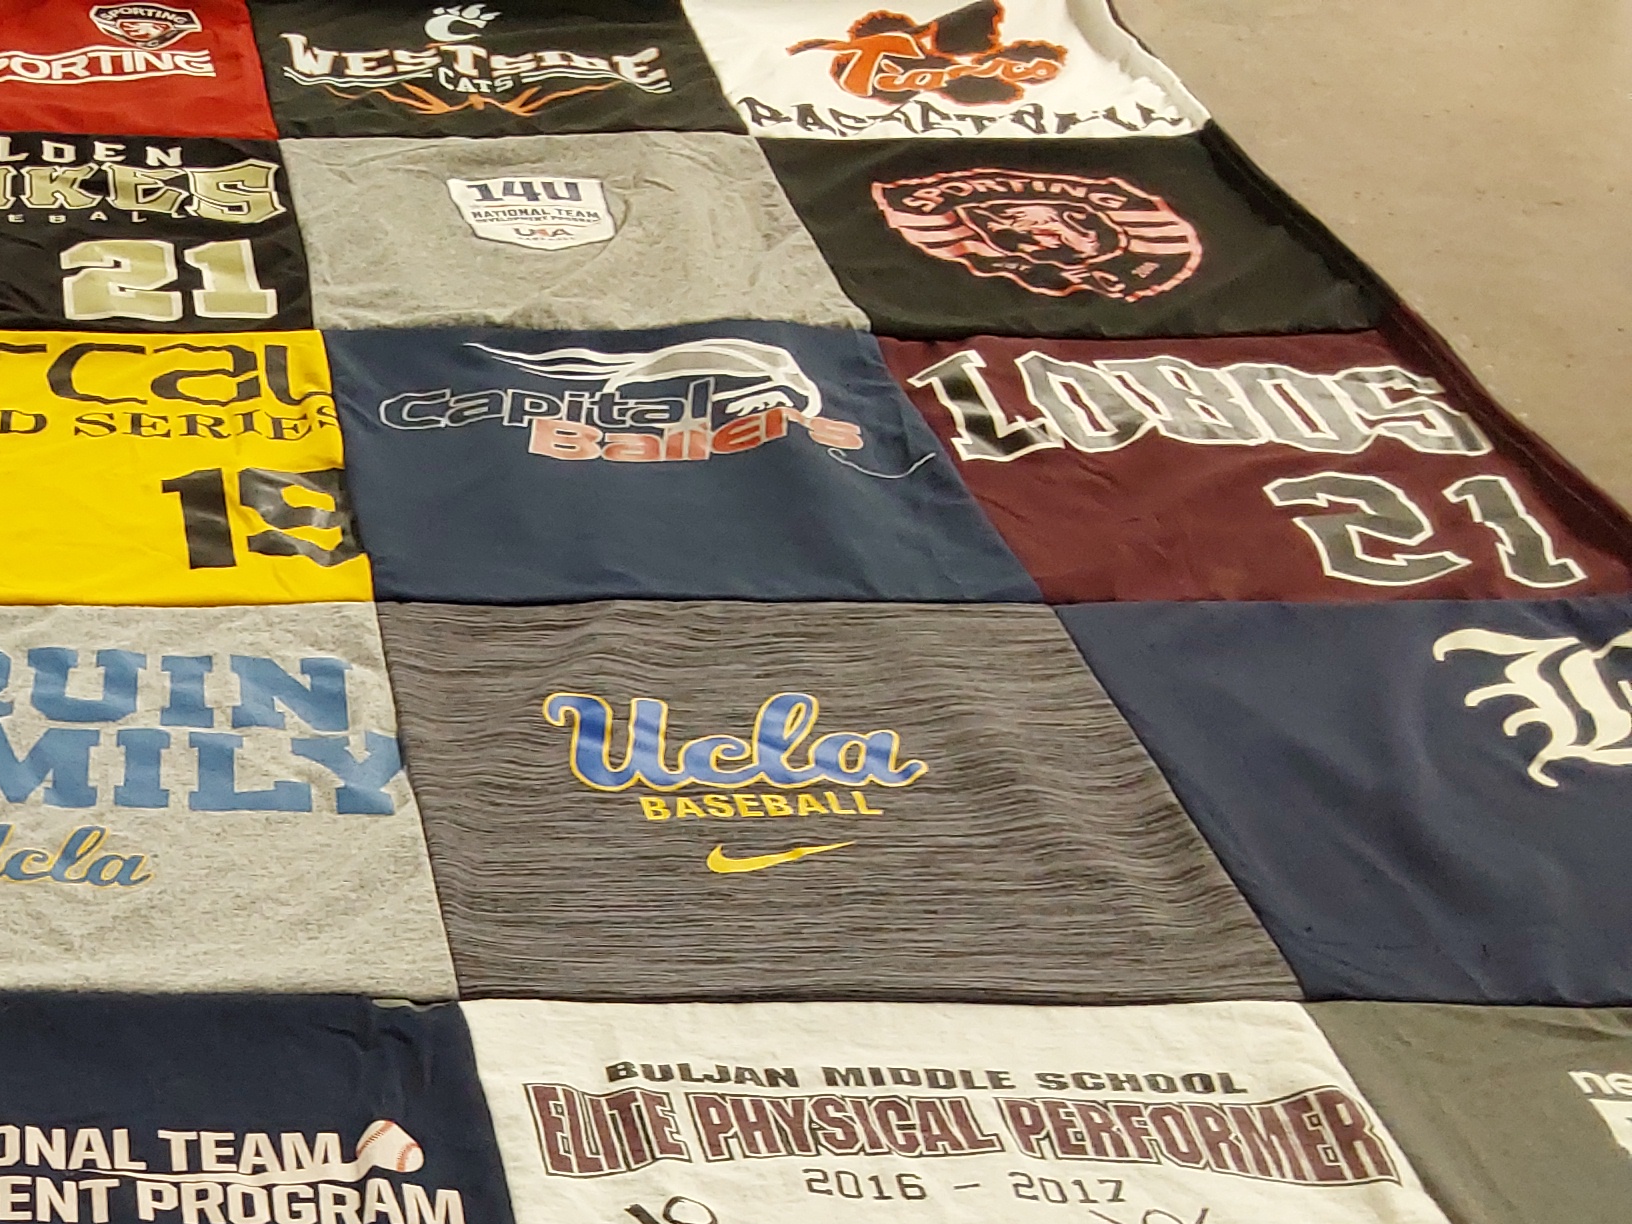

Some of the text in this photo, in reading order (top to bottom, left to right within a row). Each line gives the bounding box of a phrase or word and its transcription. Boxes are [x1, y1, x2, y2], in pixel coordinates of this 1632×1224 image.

[100, 7, 187, 24] SPORTING
[280, 33, 668, 84] WESTSIDE
[438, 66, 515, 94] CATS
[466, 181, 583, 202] 14U
[902, 178, 1127, 212] SPORTING
[471, 208, 601, 219] NATIONAL TEAM
[59, 239, 278, 321] 21
[73, 402, 338, 442] SERIES
[908, 350, 1494, 461] LOBOS
[1263, 471, 1588, 589] 21
[542, 692, 930, 792] Ucla
[638, 791, 885, 821] BASEBALL
[605, 1061, 1248, 1094] BULJAN MIDDLE SCHOOL
[157, 1127, 342, 1176] TEAM
[523, 1083, 1403, 1187] ELITE PHYSICAL PERFORMER
[804, 1168, 927, 1200] 2016
[1007, 1171, 1126, 1204] 2017
